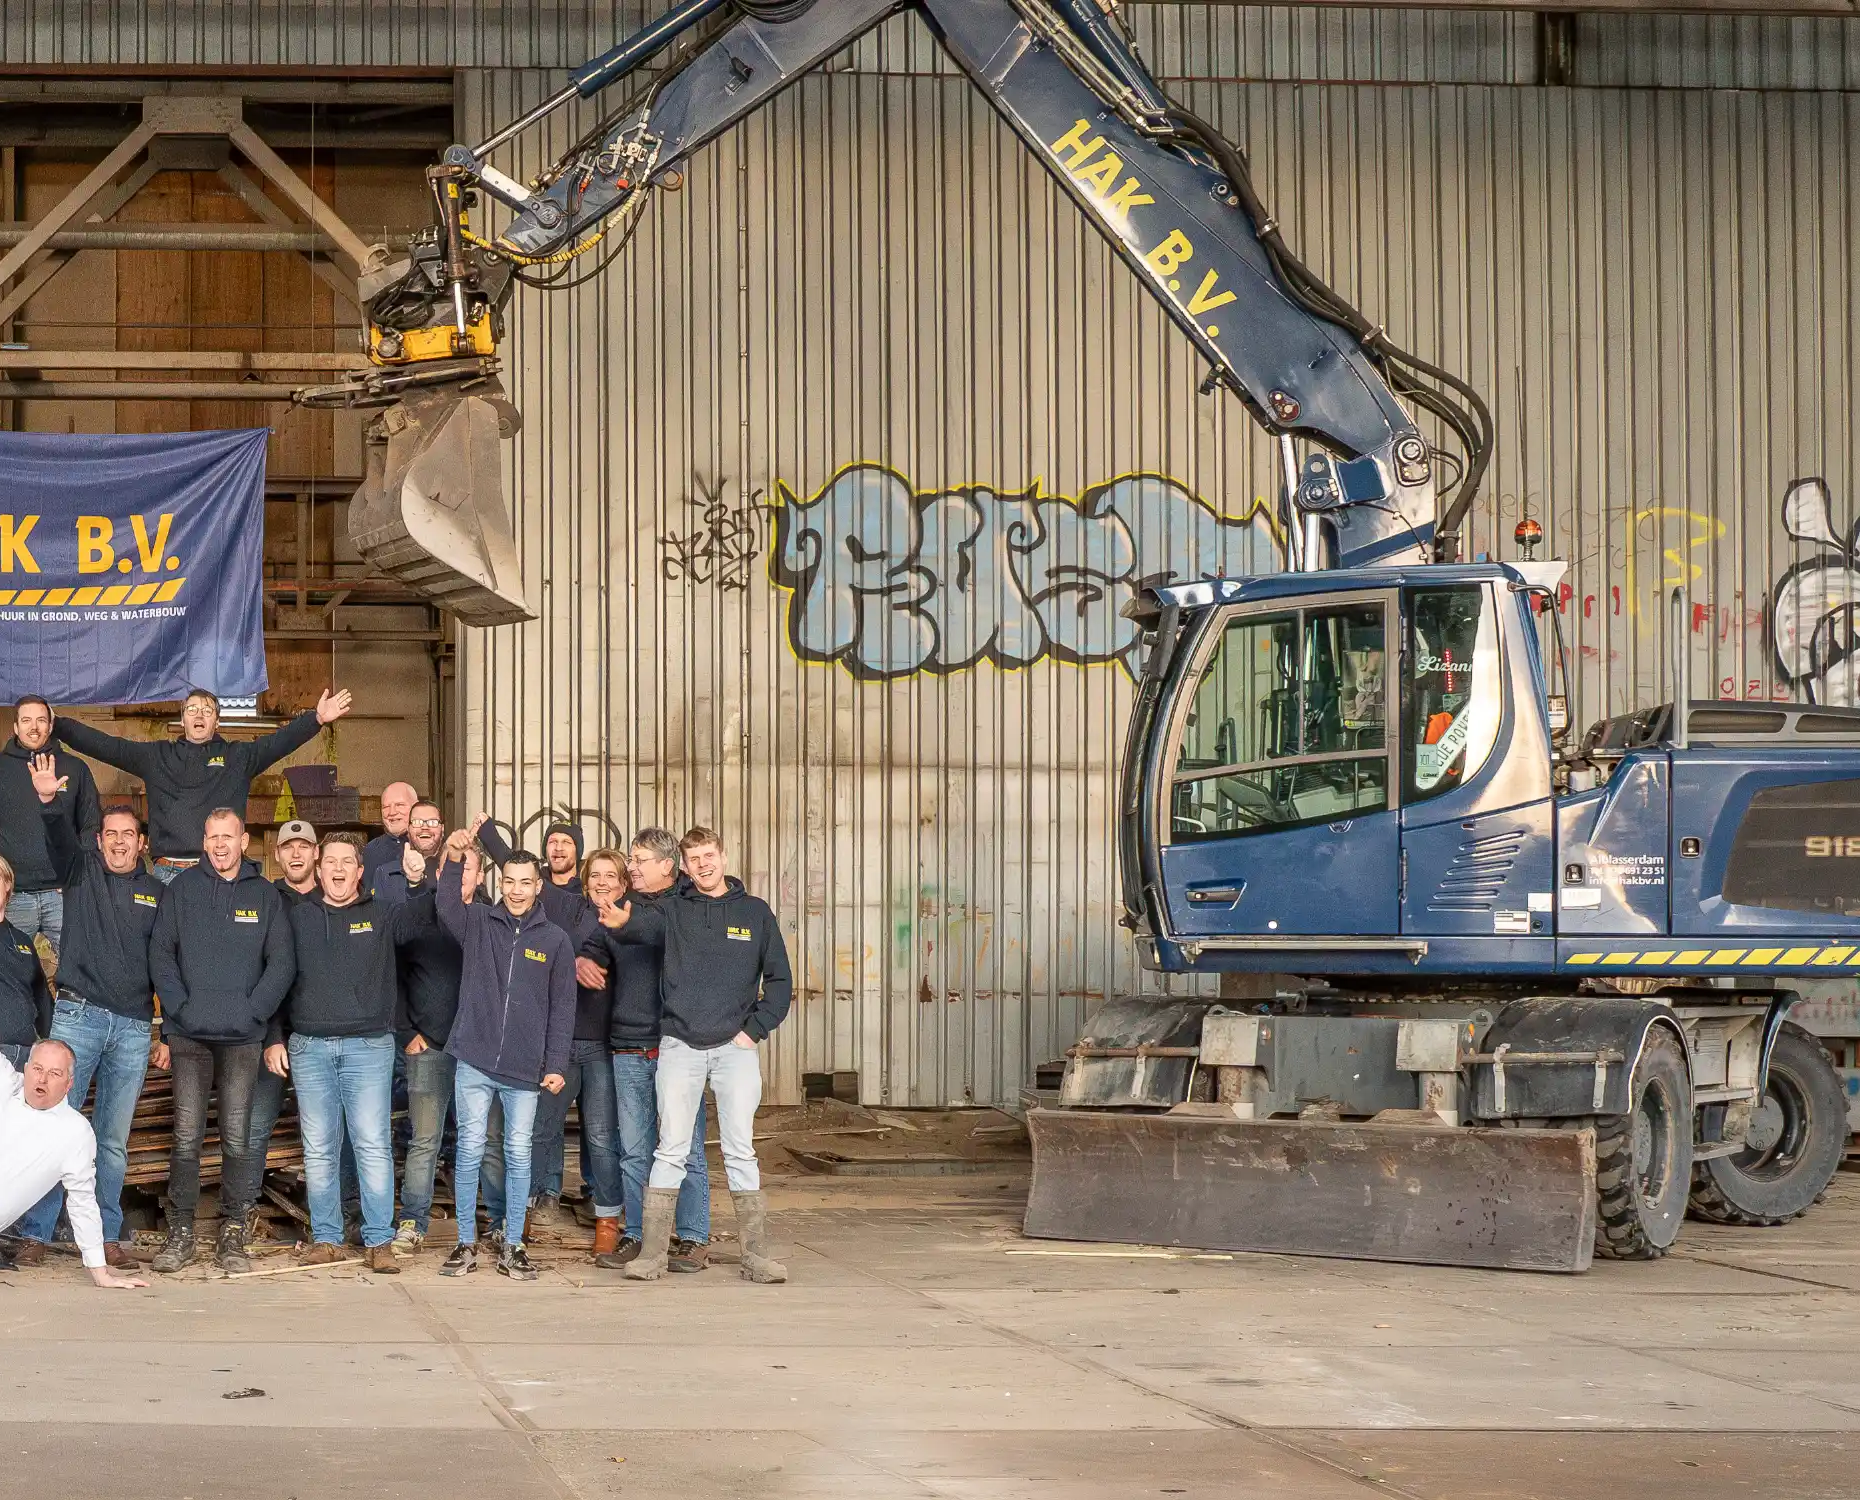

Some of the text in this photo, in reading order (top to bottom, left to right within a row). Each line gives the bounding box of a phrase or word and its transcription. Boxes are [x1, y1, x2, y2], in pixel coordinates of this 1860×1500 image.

[1051, 119, 1238, 337] HAK B.V.
[75, 513, 180, 574] B.V.
[28, 611, 39, 621] IN
[41, 611, 82, 622] GROND,
[84, 611, 108, 621] WEG
[111, 611, 119, 621] &
[122, 606, 187, 620] WATERBOUW
[1590, 854, 1664, 864] Alblasserdam
[1642, 867, 1653, 875] 23
[1654, 867, 1664, 875] 51
[1589, 876, 1664, 886] infhakbv.nl
